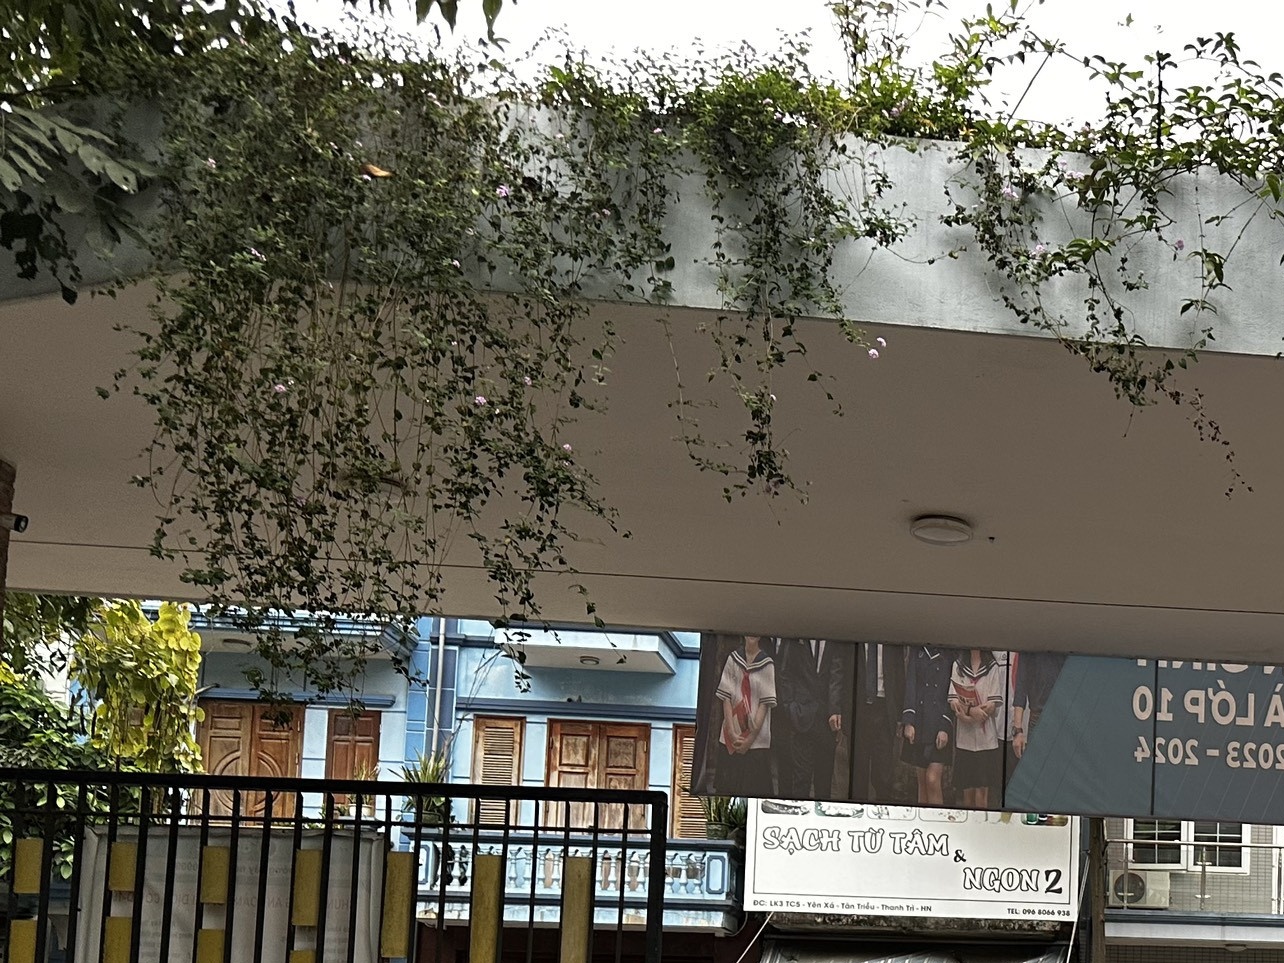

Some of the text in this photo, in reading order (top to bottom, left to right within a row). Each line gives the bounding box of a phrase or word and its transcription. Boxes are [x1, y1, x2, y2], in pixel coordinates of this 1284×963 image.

[762, 826, 967, 863] SẠCH TỪ TÂM &
[963, 867, 1063, 894] NGON 2
